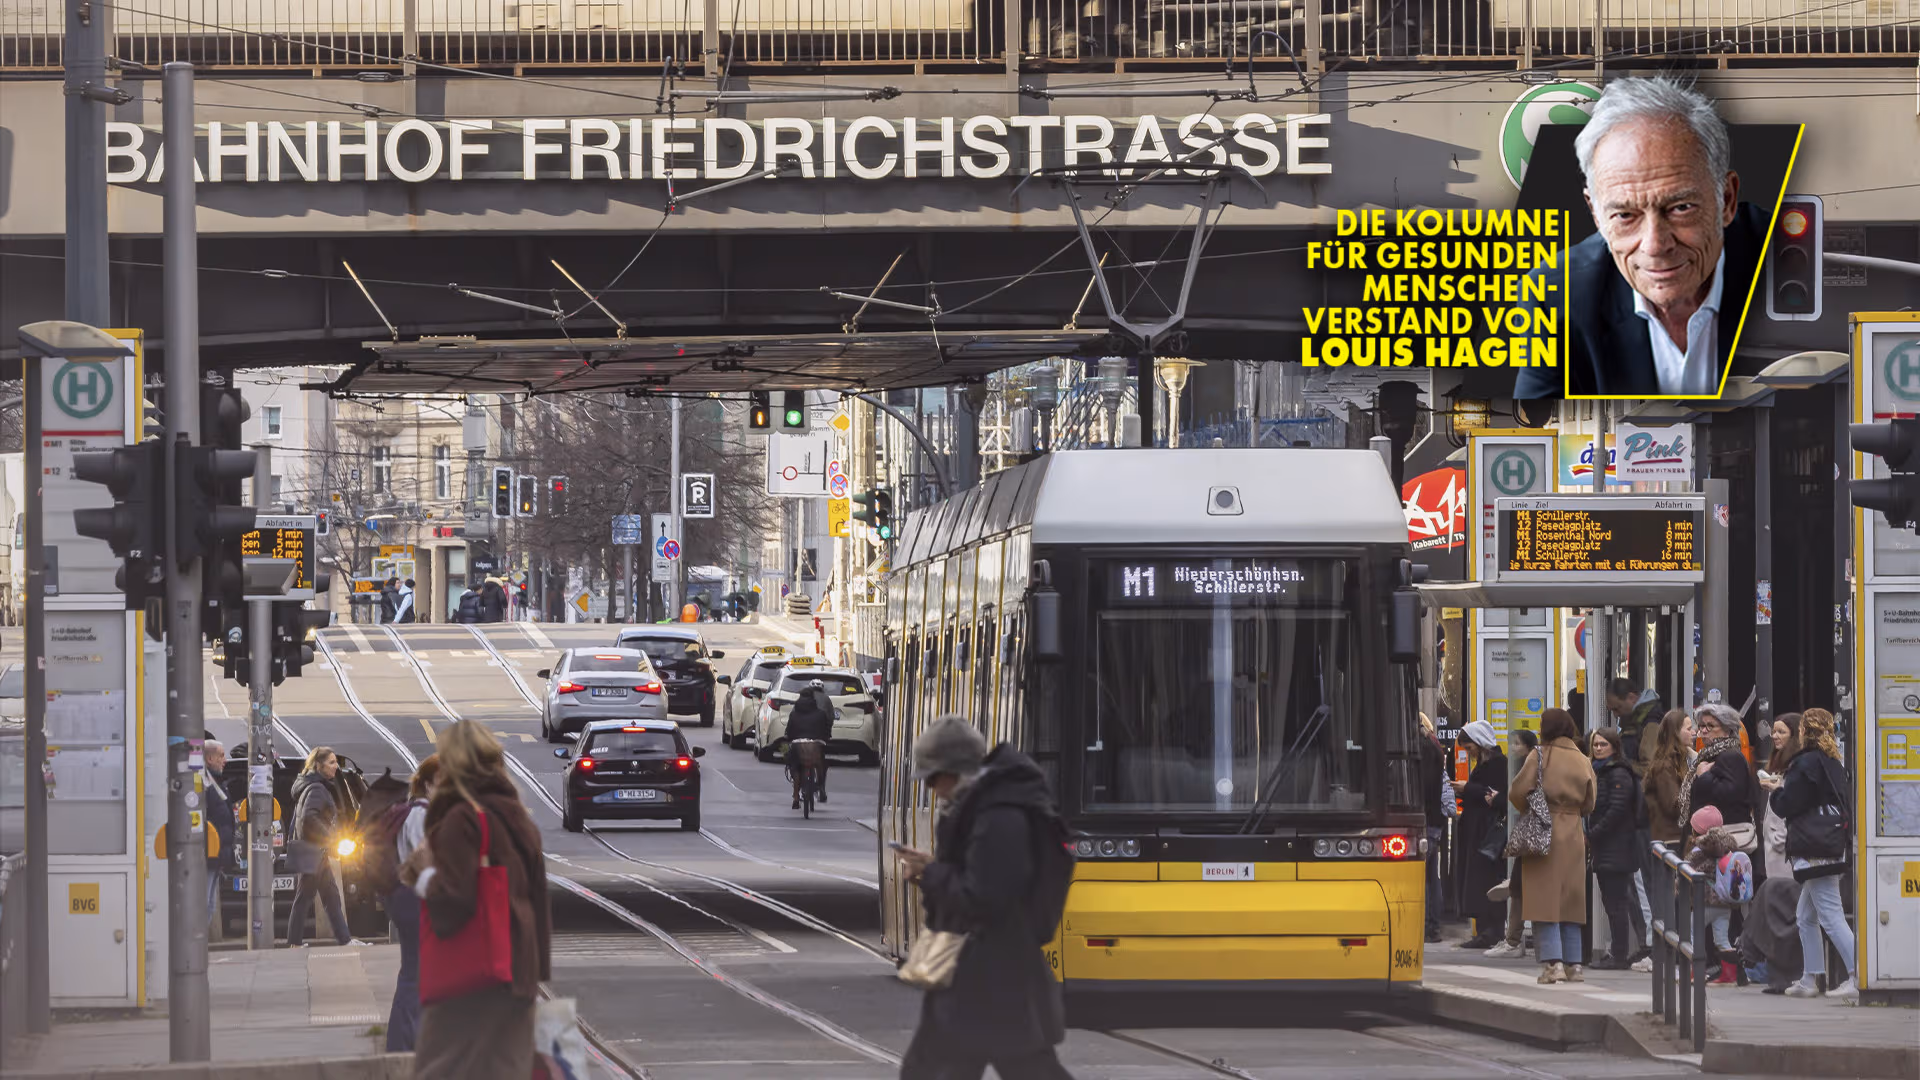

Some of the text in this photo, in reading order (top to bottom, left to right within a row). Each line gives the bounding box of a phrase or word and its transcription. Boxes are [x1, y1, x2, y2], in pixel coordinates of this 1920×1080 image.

[523, 113, 1332, 181] FRIEDRICHSTRASSE
[67, 371, 98, 405] H
[1624, 432, 1687, 460] Pink
[52, 467, 61, 475] 12
[1502, 460, 1525, 485] H
[1516, 511, 1590, 521] M1 Schillerstr.
[1517, 520, 1692, 533] 12 Pasedagplatz 1 min
[276, 528, 283, 538] 4
[285, 528, 303, 538] min
[1516, 530, 1692, 541] M1 Rosenthal Nord 8 min
[276, 538, 283, 548] 5
[285, 538, 303, 548] min
[1413, 536, 1447, 550] Kabarett
[1517, 540, 1692, 552] 12 Pasedagplatz 9 min
[272, 548, 283, 558] 12
[285, 548, 303, 558] min
[1516, 550, 1692, 560] M1 Schillerstr. 16 min
[1523, 560, 1551, 570] kurze
[1595, 560, 1611, 570] mit
[1174, 566, 1305, 582] Niederschönhsn.
[1124, 566, 1155, 597] M1
[1194, 580, 1287, 594] Schillerstr.
[1205, 867, 1235, 876] BERLIN
[274, 878, 293, 889] 139
[72, 898, 96, 912] BVG
